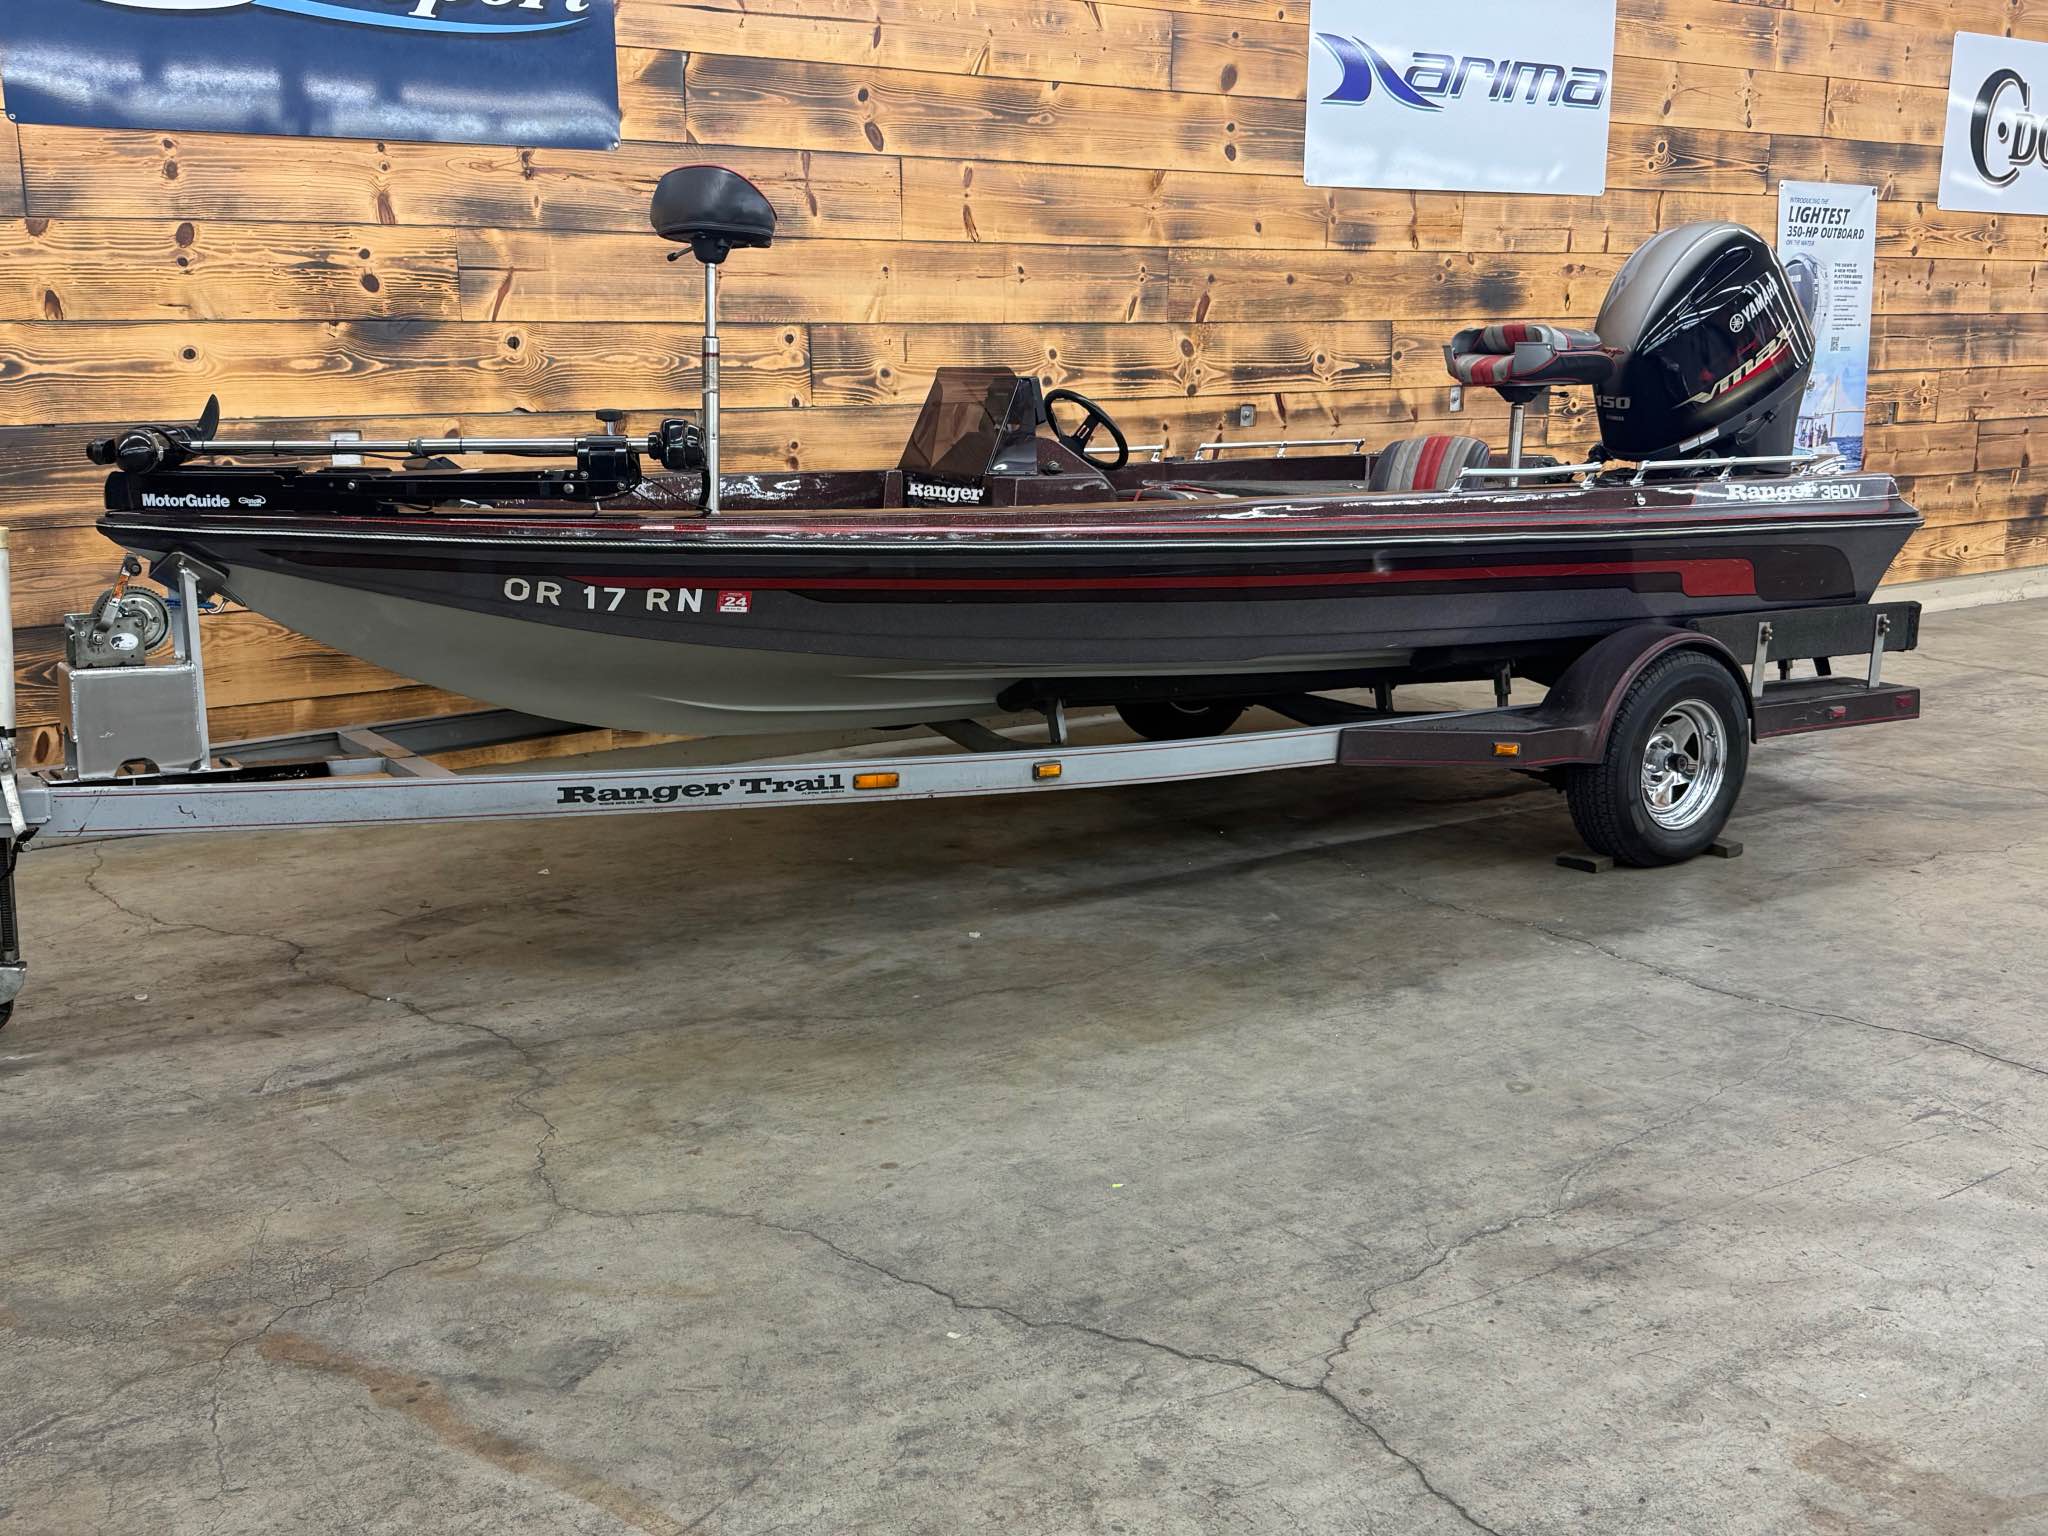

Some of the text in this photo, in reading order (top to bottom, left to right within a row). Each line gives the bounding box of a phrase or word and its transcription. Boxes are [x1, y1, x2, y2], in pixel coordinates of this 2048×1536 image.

[1788, 205, 1851, 226] LIGHTEST
[1786, 225, 1865, 240] 350-HP OUTBOARD
[1741, 277, 1779, 322] YAMAHA
[141, 493, 231, 509] MotorGuide
[907, 483, 984, 503] Ranger
[1820, 483, 1861, 499] 360V
[503, 577, 703, 613] OR 17 RN
[724, 596, 747, 607] 24
[557, 774, 845, 804] Ranger Trail
